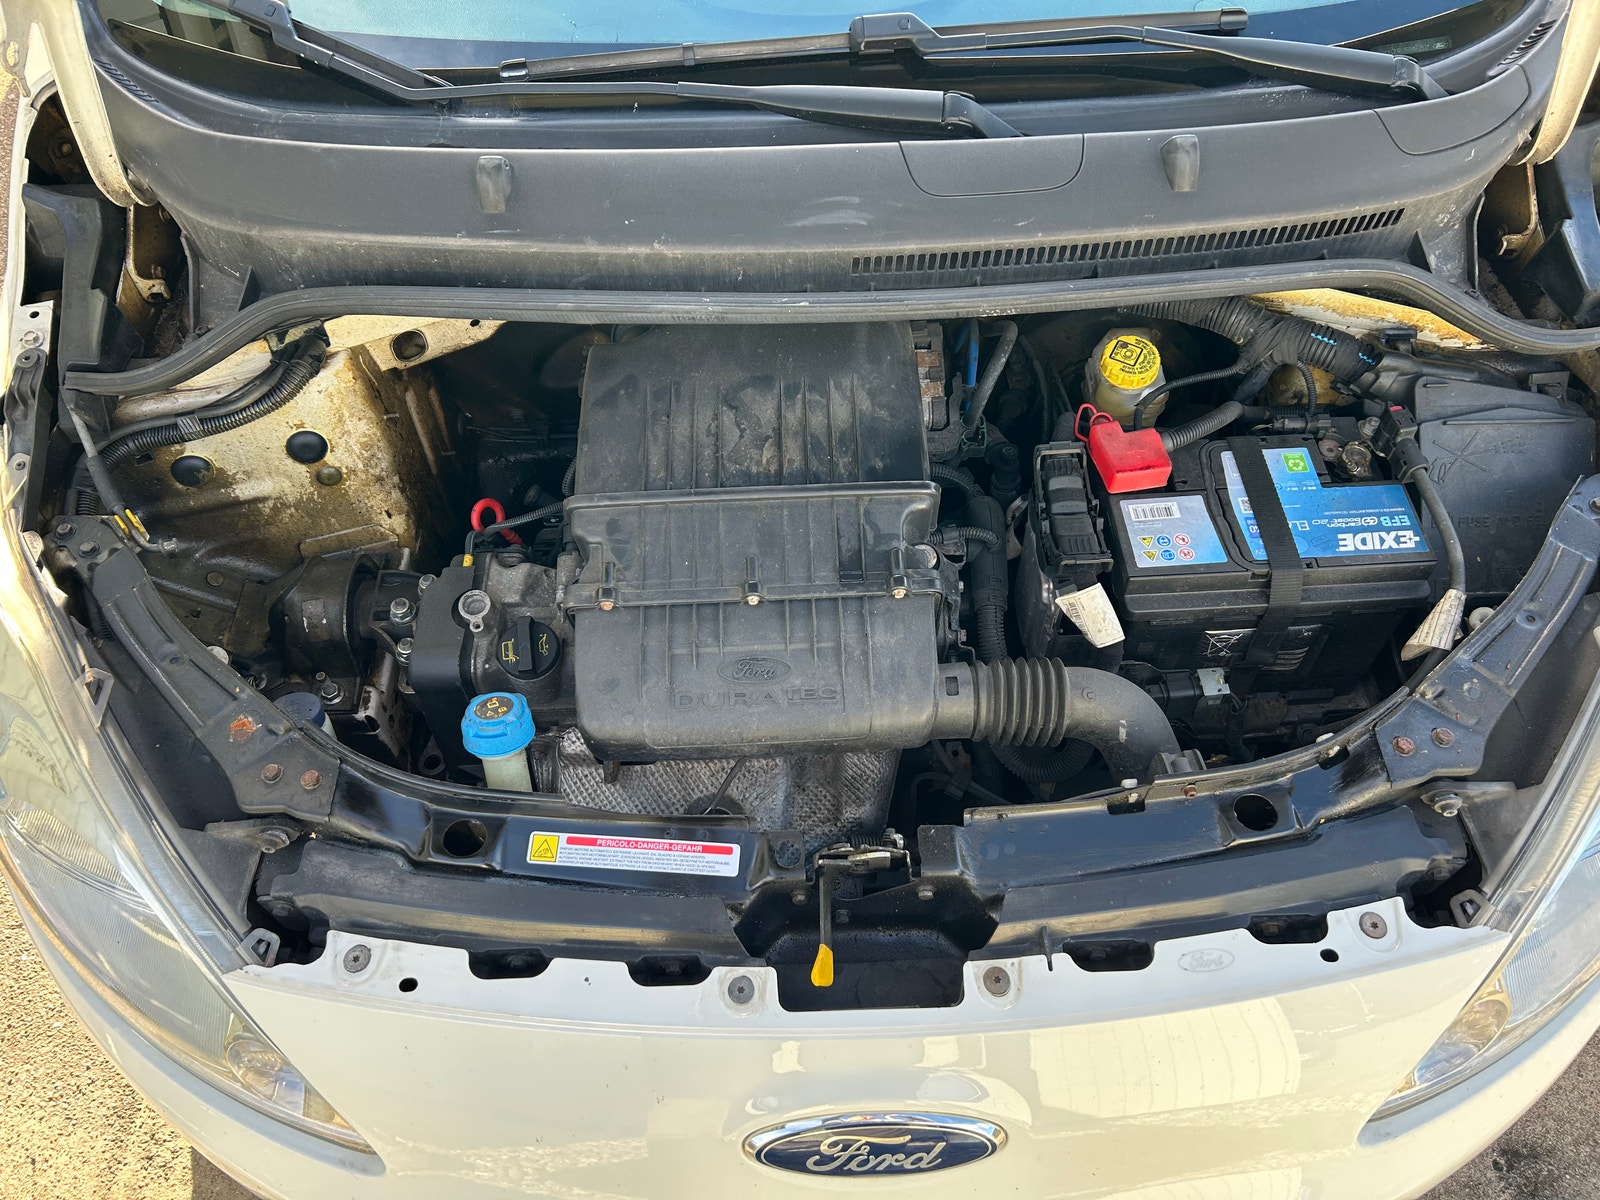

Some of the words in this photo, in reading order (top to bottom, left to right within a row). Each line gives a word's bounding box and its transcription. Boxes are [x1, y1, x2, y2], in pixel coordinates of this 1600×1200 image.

[1380, 514, 1411, 527] EFB
[1337, 530, 1420, 551] EXIDE
[732, 657, 776, 680] Ford
[673, 686, 838, 710] DURATEC
[596, 839, 703, 852] PERICOLO-DANGER-GEFAHR
[806, 1134, 947, 1172] Ford
